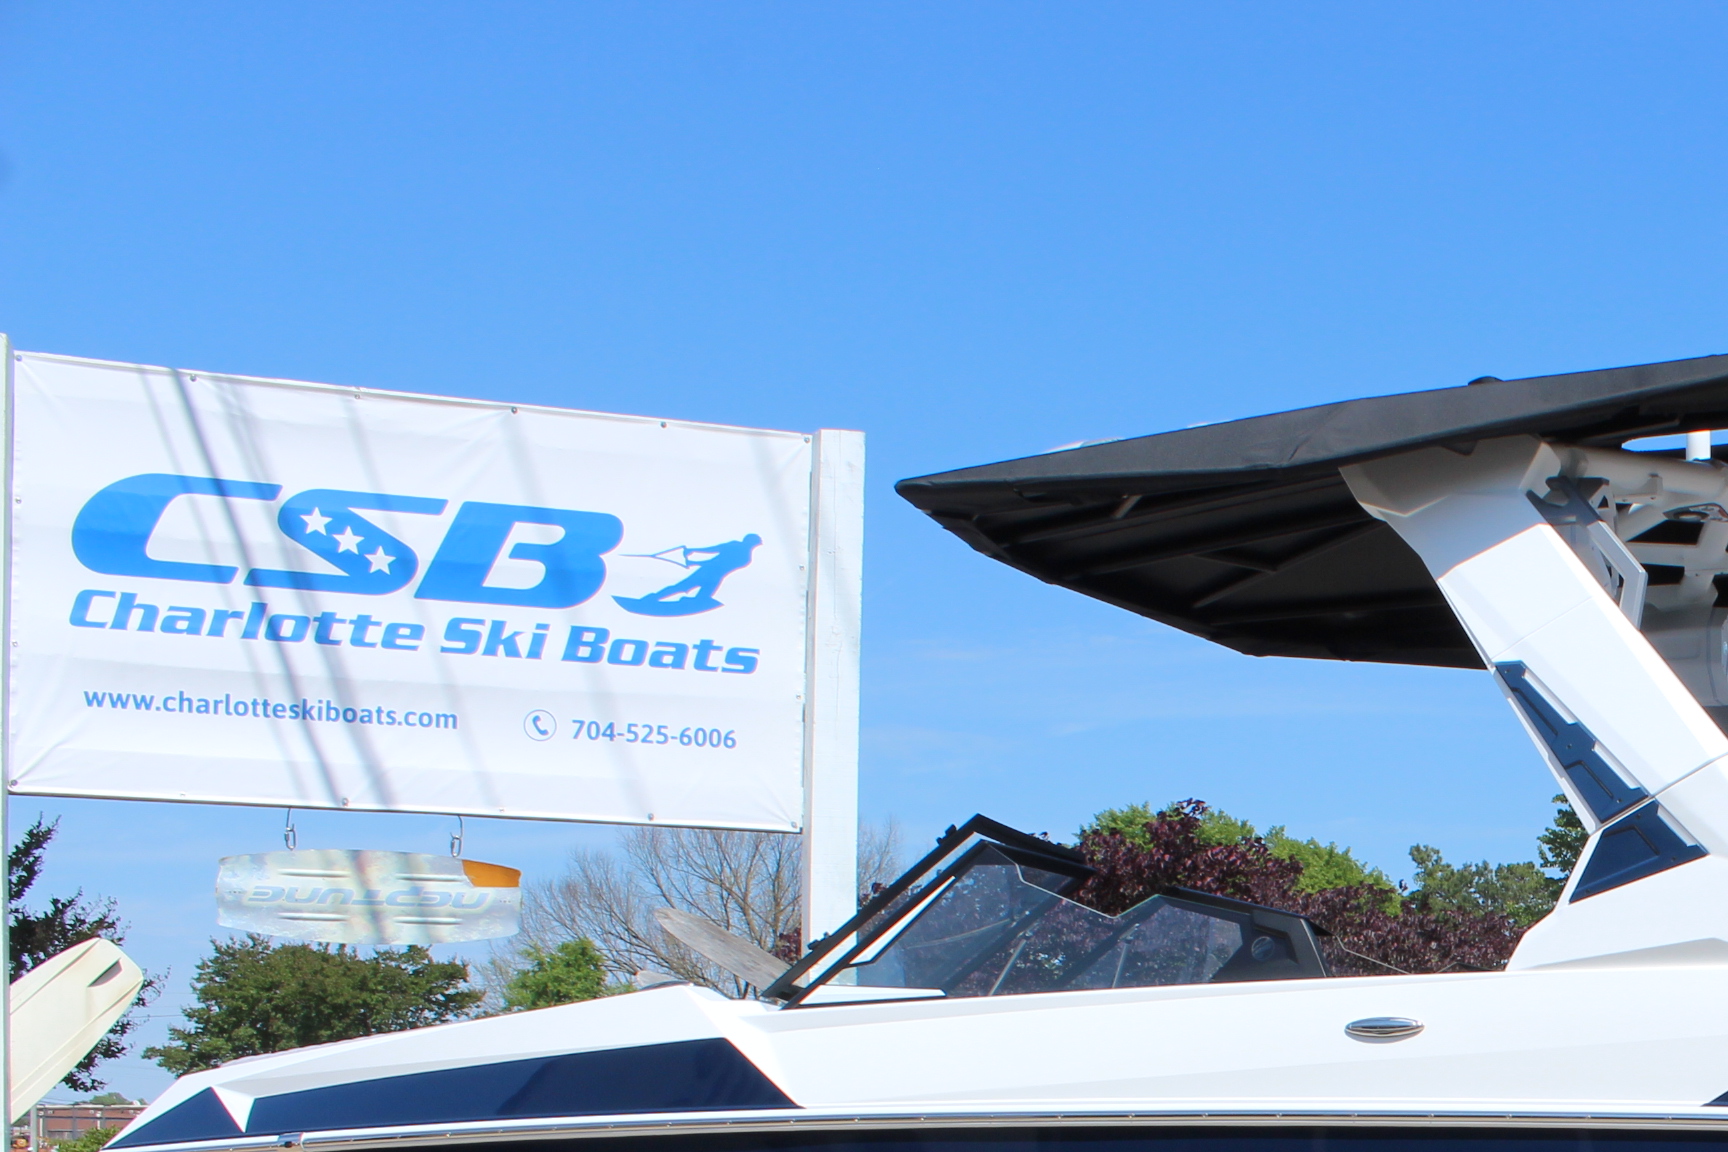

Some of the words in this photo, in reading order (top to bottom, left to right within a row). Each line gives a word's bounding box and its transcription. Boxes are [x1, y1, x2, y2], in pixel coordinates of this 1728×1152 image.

[72, 473, 622, 608] CSB
[69, 589, 425, 651] Charlotte
[440, 616, 547, 659] Ski
[561, 625, 760, 674] Boats
[83, 690, 458, 729] www.charlotteskiboats.com
[571, 718, 737, 749] 704-525-6006
